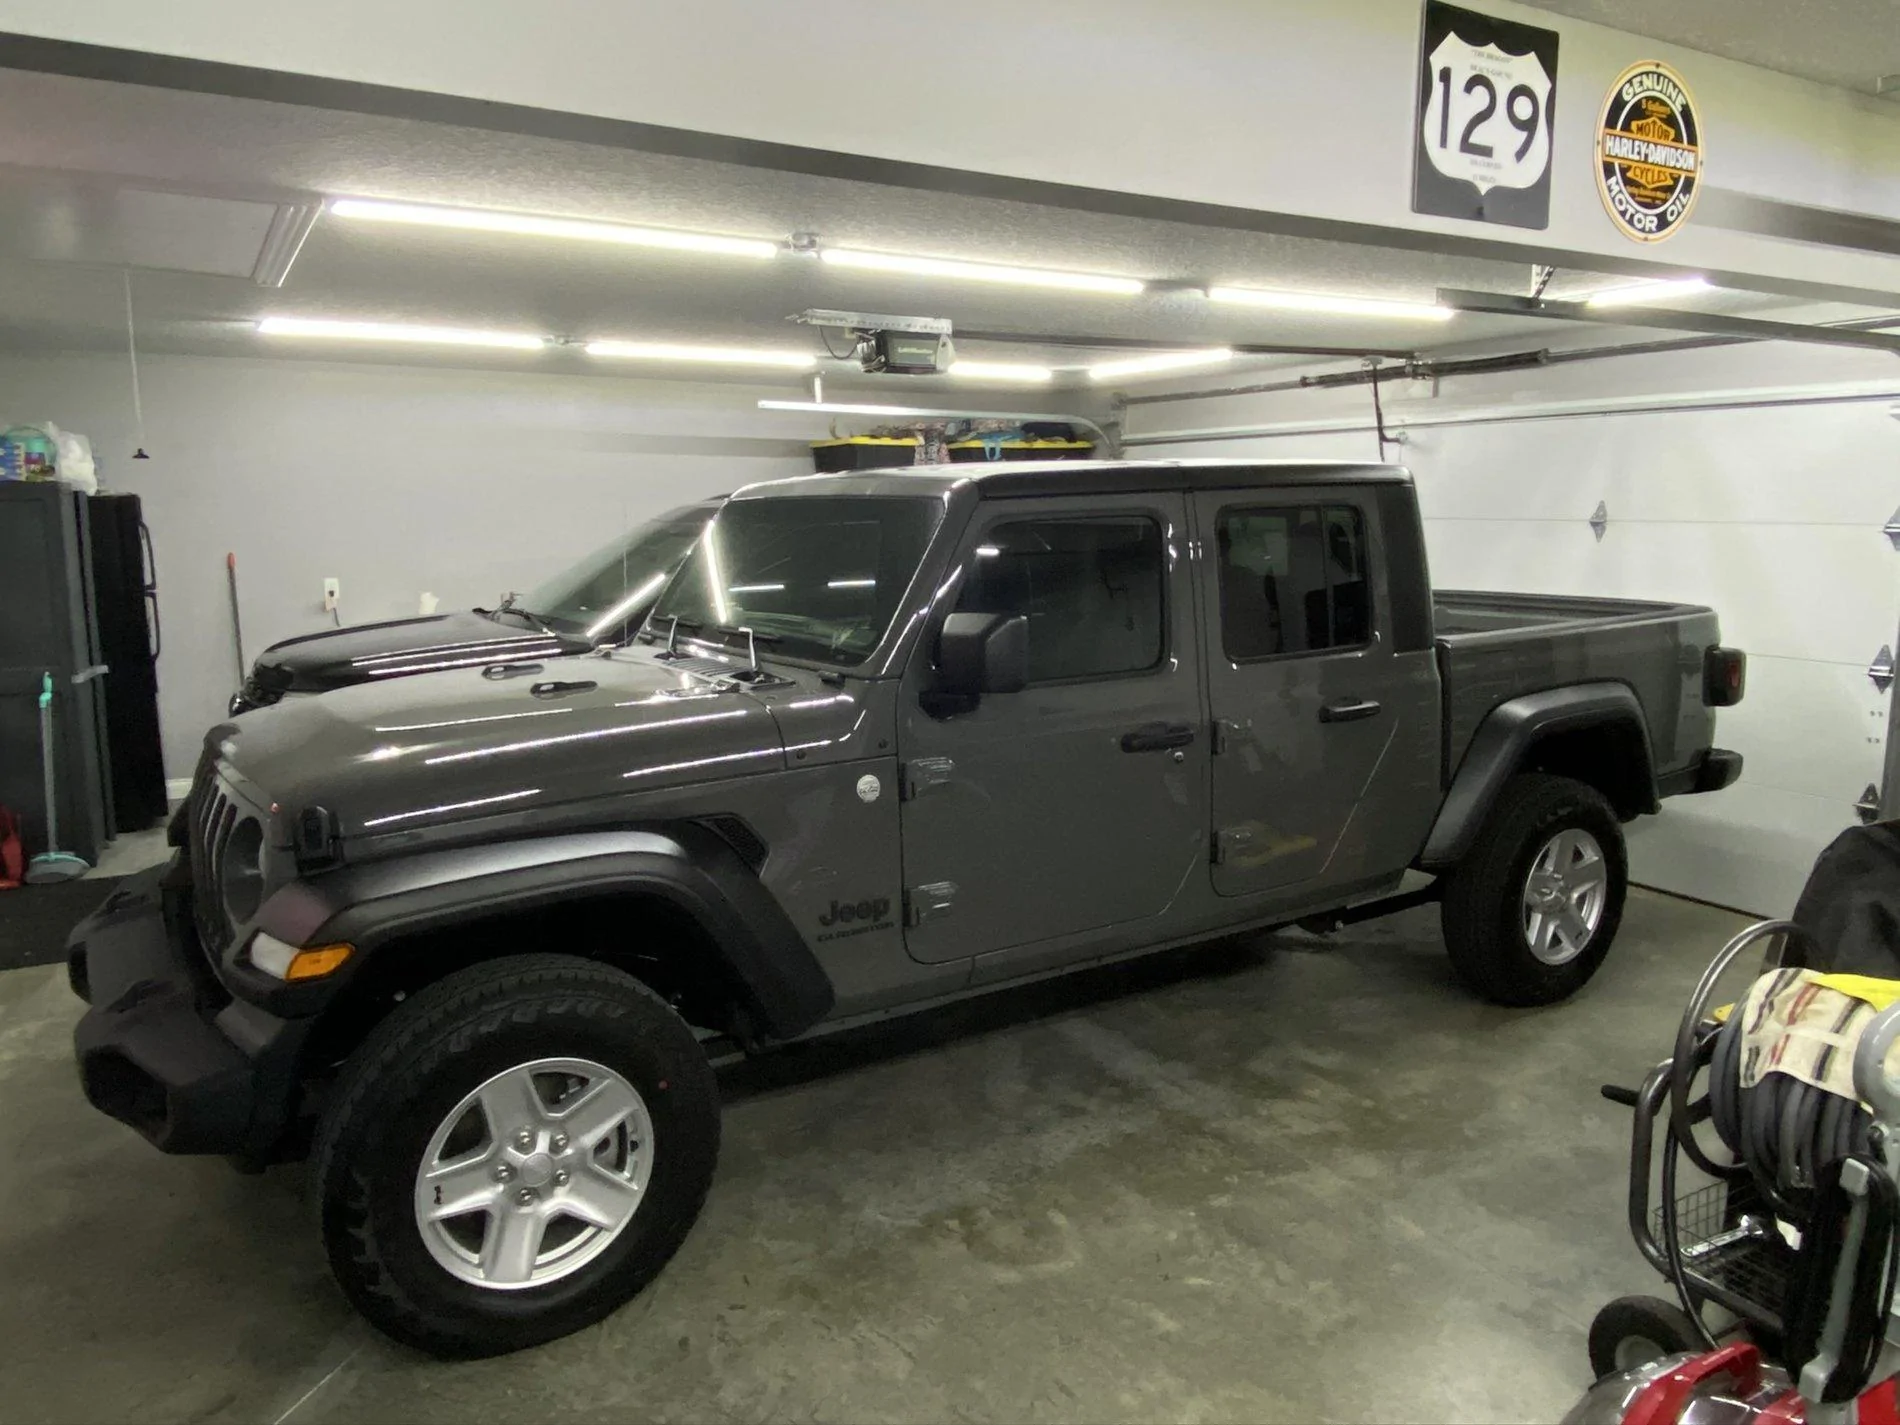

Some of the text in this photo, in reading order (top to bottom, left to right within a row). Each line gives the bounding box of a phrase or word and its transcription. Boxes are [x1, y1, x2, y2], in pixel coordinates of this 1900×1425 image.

[1621, 73, 1687, 113] GENUINE
[1438, 66, 1540, 164] 129
[1635, 119, 1671, 141] MOTOR
[1605, 134, 1696, 171] HARLEY-DAVIDSON
[1632, 165, 1668, 185] CYCLES
[1606, 175, 1658, 232] MOTOR
[1666, 192, 1691, 222] OIL
[819, 898, 890, 926] Jeep
